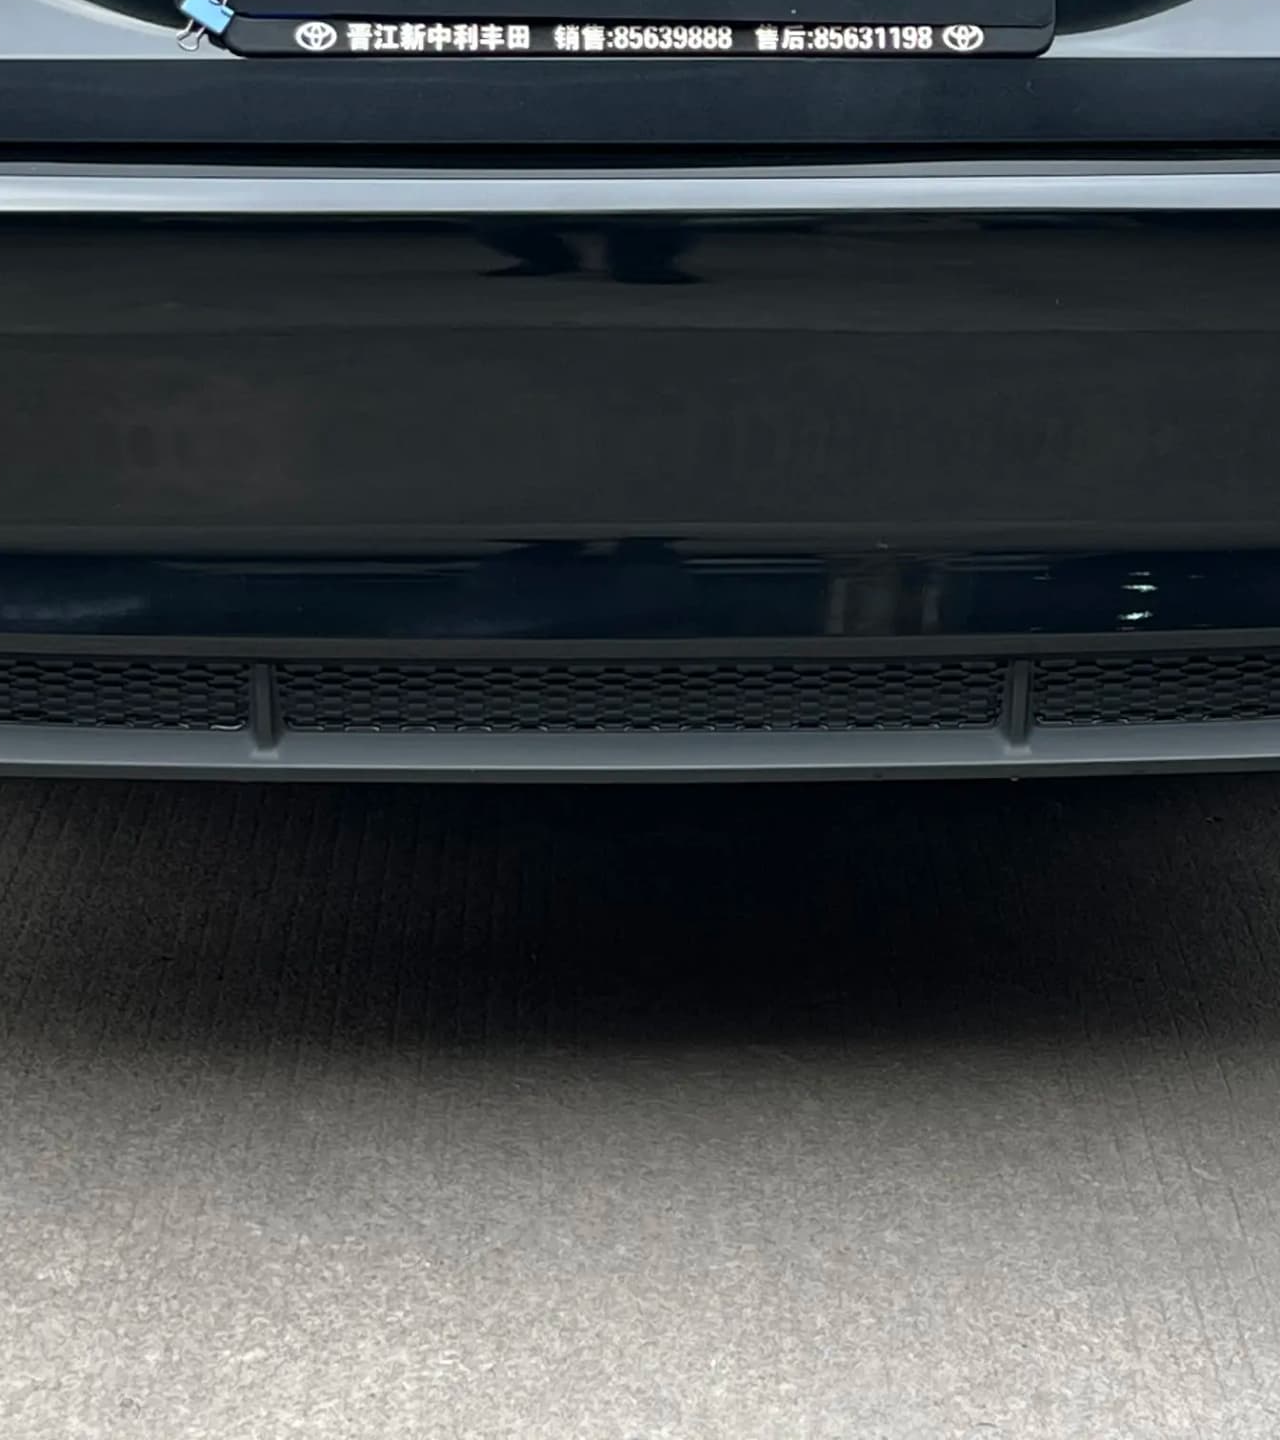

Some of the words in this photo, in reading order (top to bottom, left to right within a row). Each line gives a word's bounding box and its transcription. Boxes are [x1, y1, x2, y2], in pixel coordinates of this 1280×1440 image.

[347, 23, 530, 51] 晋江新中利丰田
